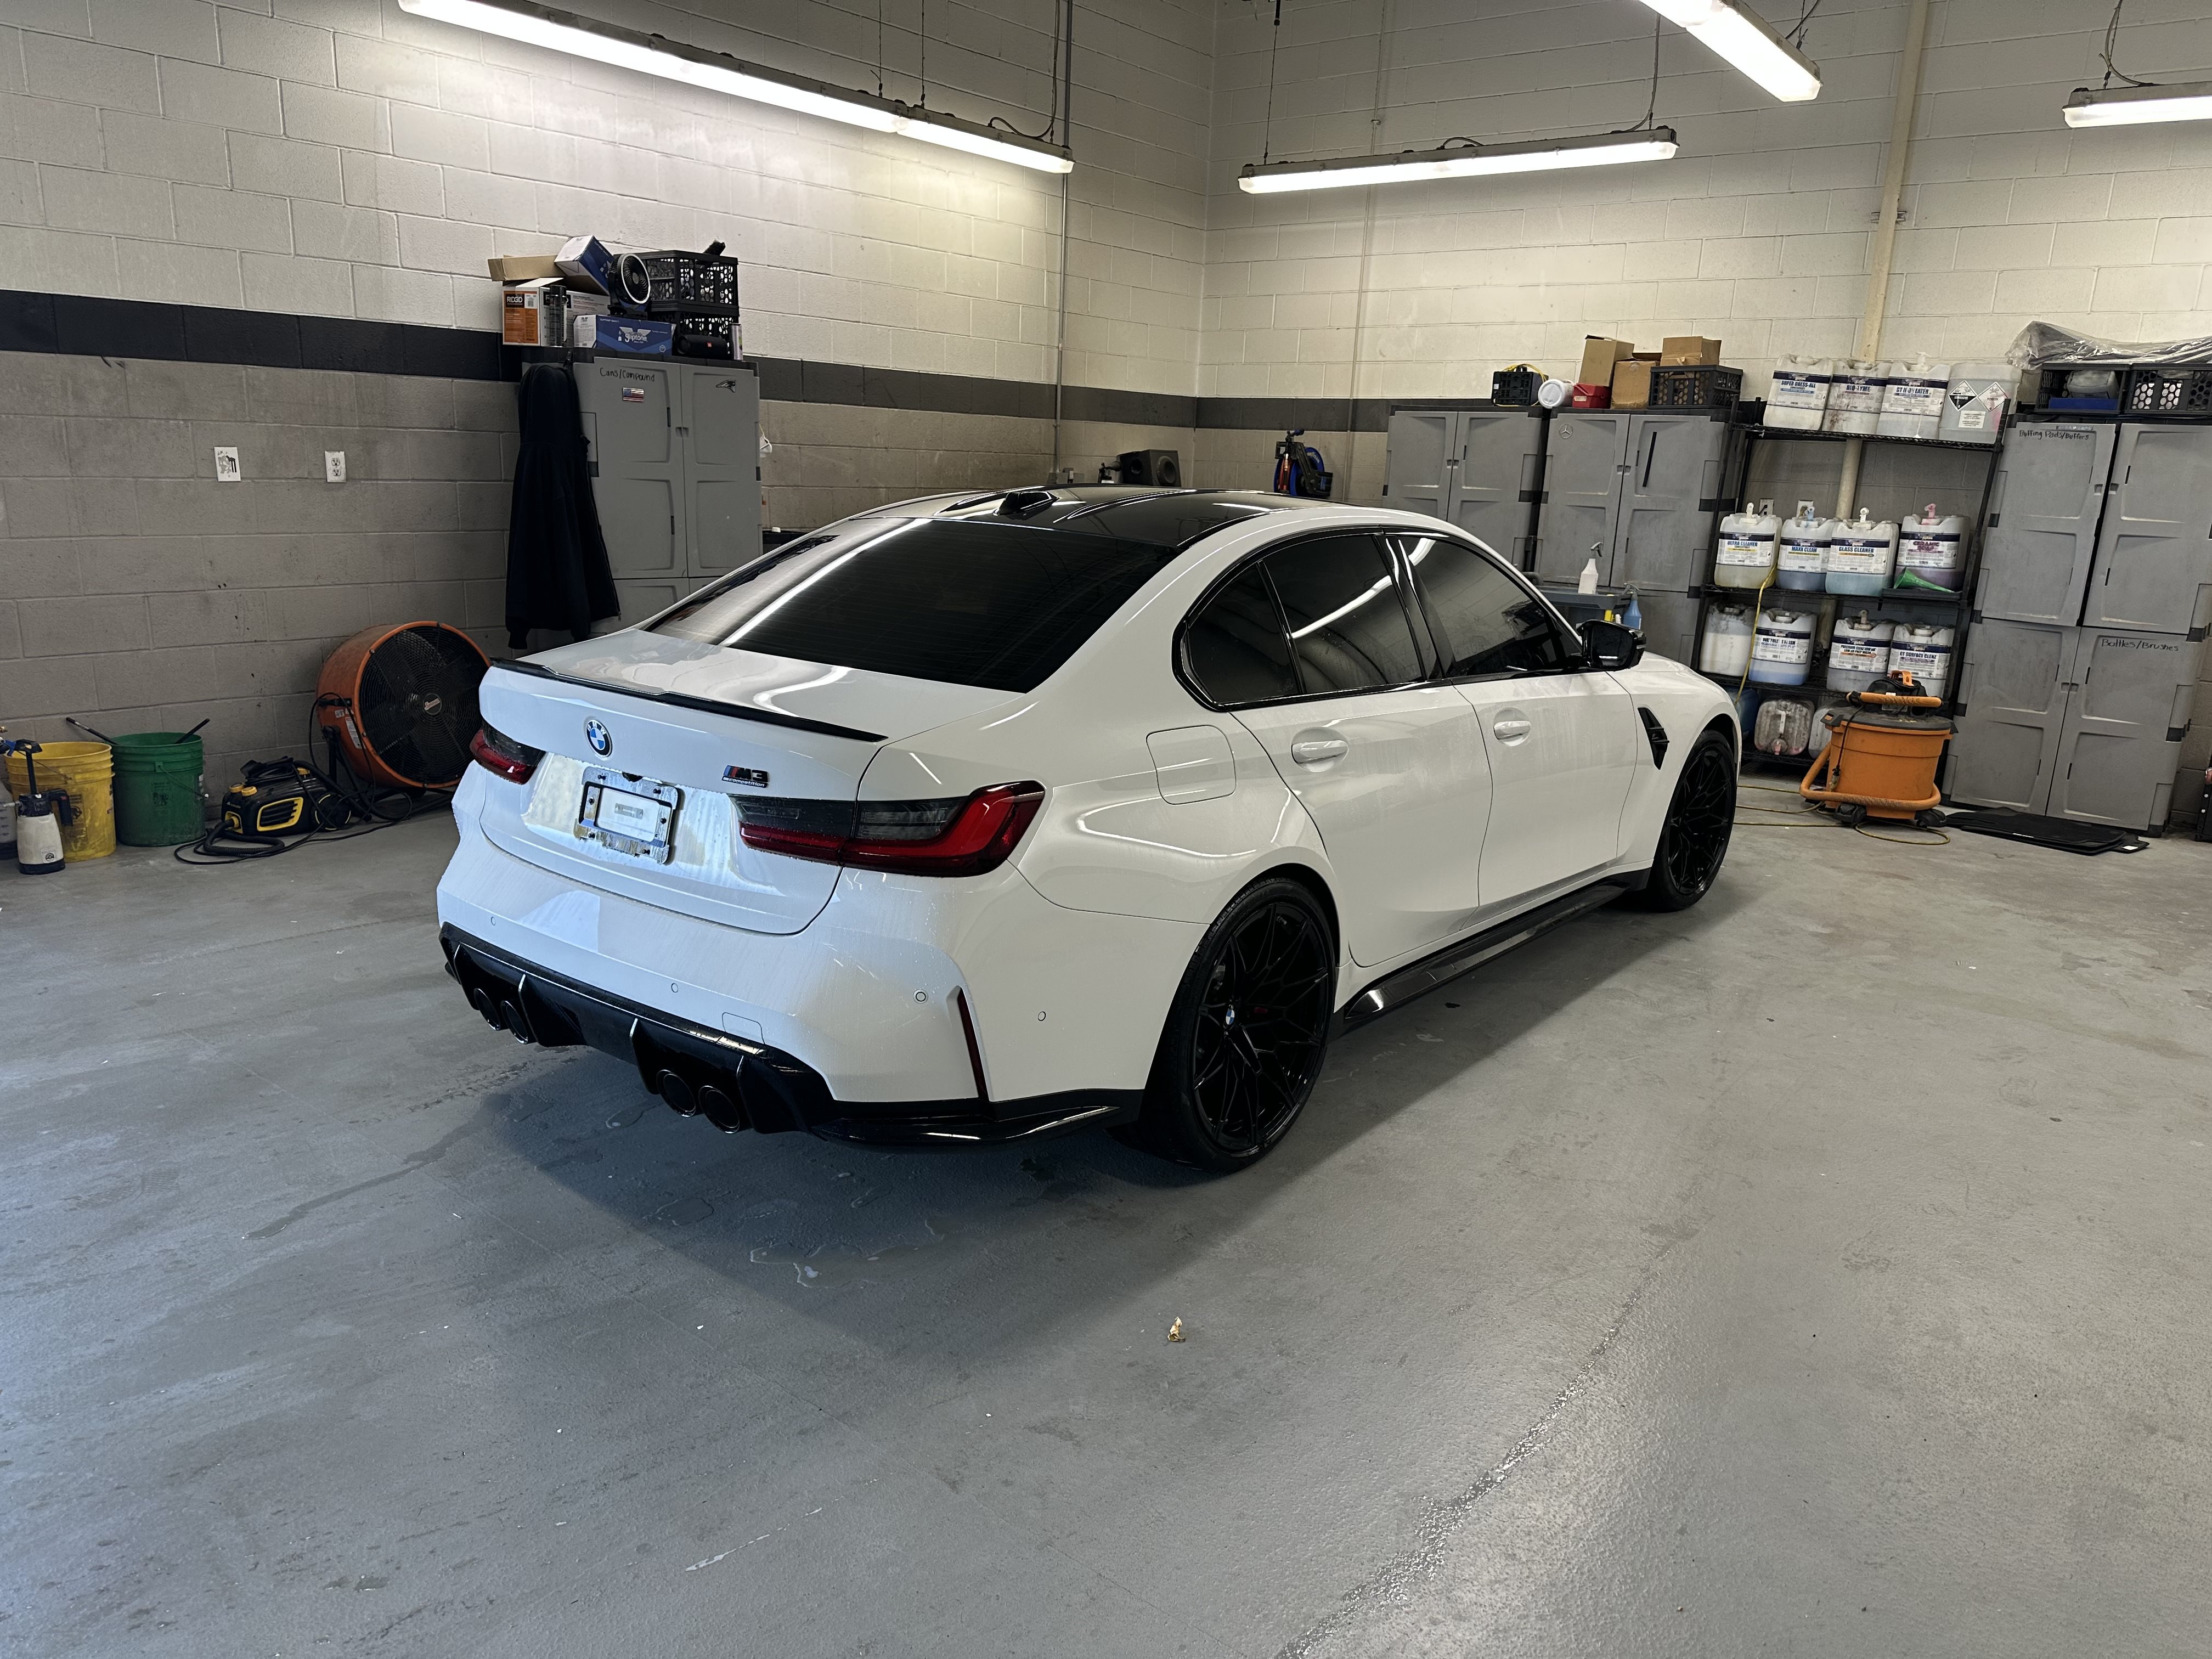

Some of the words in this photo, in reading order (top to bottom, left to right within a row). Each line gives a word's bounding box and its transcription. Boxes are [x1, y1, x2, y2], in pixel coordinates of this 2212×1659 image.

[625, 332, 647, 343] gliptone
[600, 368, 655, 382] Cans/Compound
[2019, 430, 2042, 440] Buffing
[2045, 431, 2090, 440] Pads/Buffers
[2101, 639, 2179, 651] Bottles/Brushes
[587, 720, 606, 735] BMW
[733, 766, 769, 783] M3
[729, 778, 765, 787] competition
